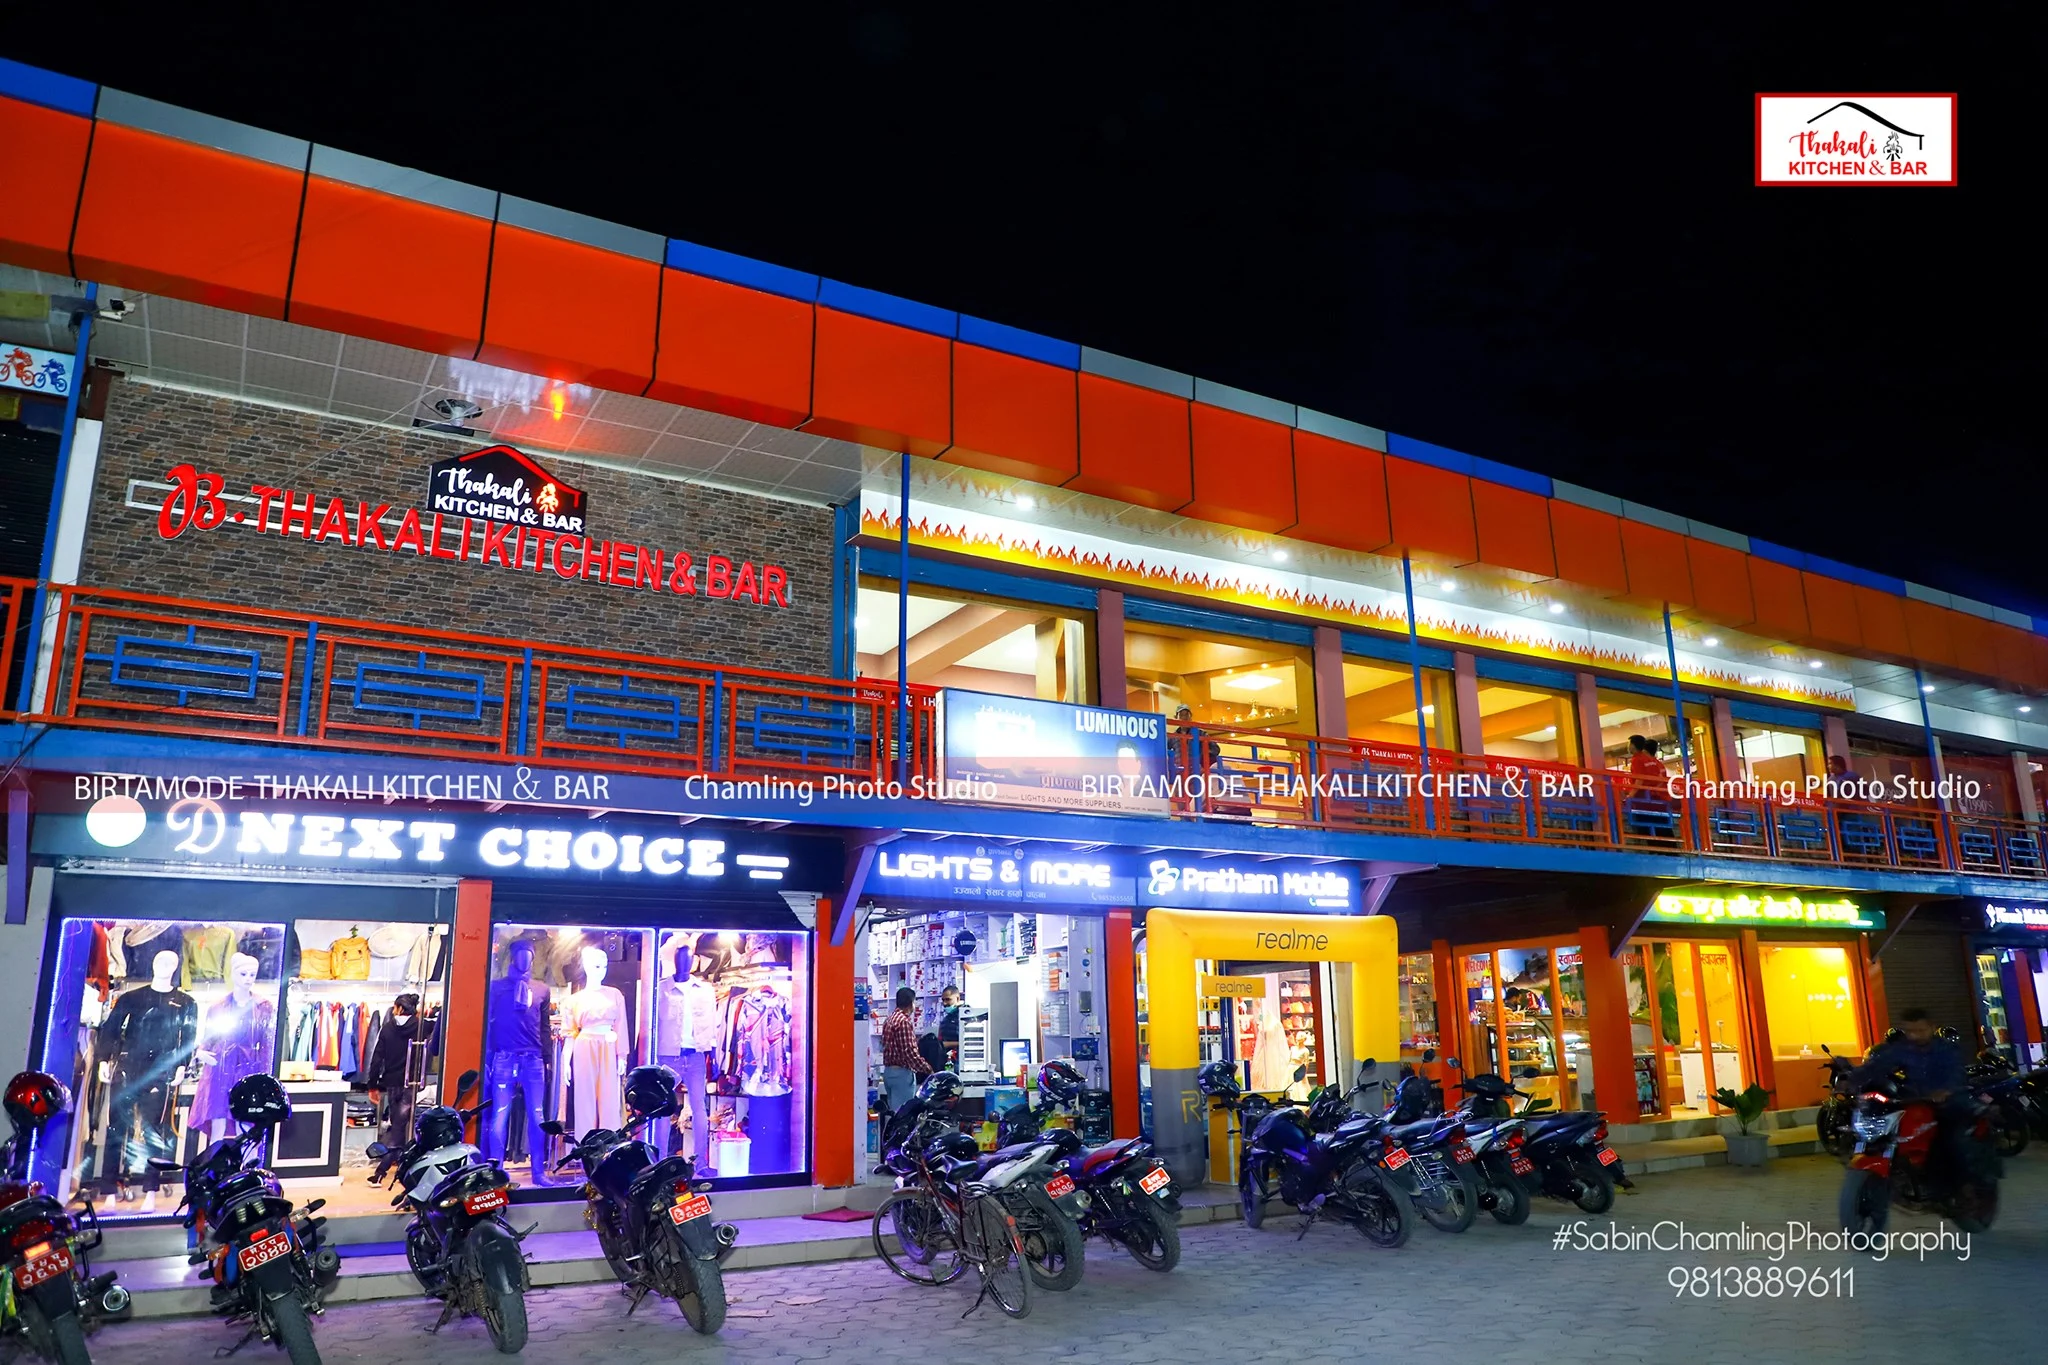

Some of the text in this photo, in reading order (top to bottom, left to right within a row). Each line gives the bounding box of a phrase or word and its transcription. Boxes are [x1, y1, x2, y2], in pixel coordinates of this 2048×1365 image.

[438, 467, 532, 506] Thakali
[543, 512, 583, 532] BAR
[482, 521, 663, 592] KITCHEN
[669, 552, 697, 596] &
[706, 555, 788, 608] BAR
[1075, 709, 1158, 740] LUMINOUS
[239, 811, 456, 862] NEXT
[479, 827, 725, 876] CHOICE
[879, 852, 1111, 888] LIGHTS & MORE
[1183, 867, 1349, 897] Pratham Mobile
[1256, 928, 1329, 951] realme
[1216, 980, 1253, 994] realme
